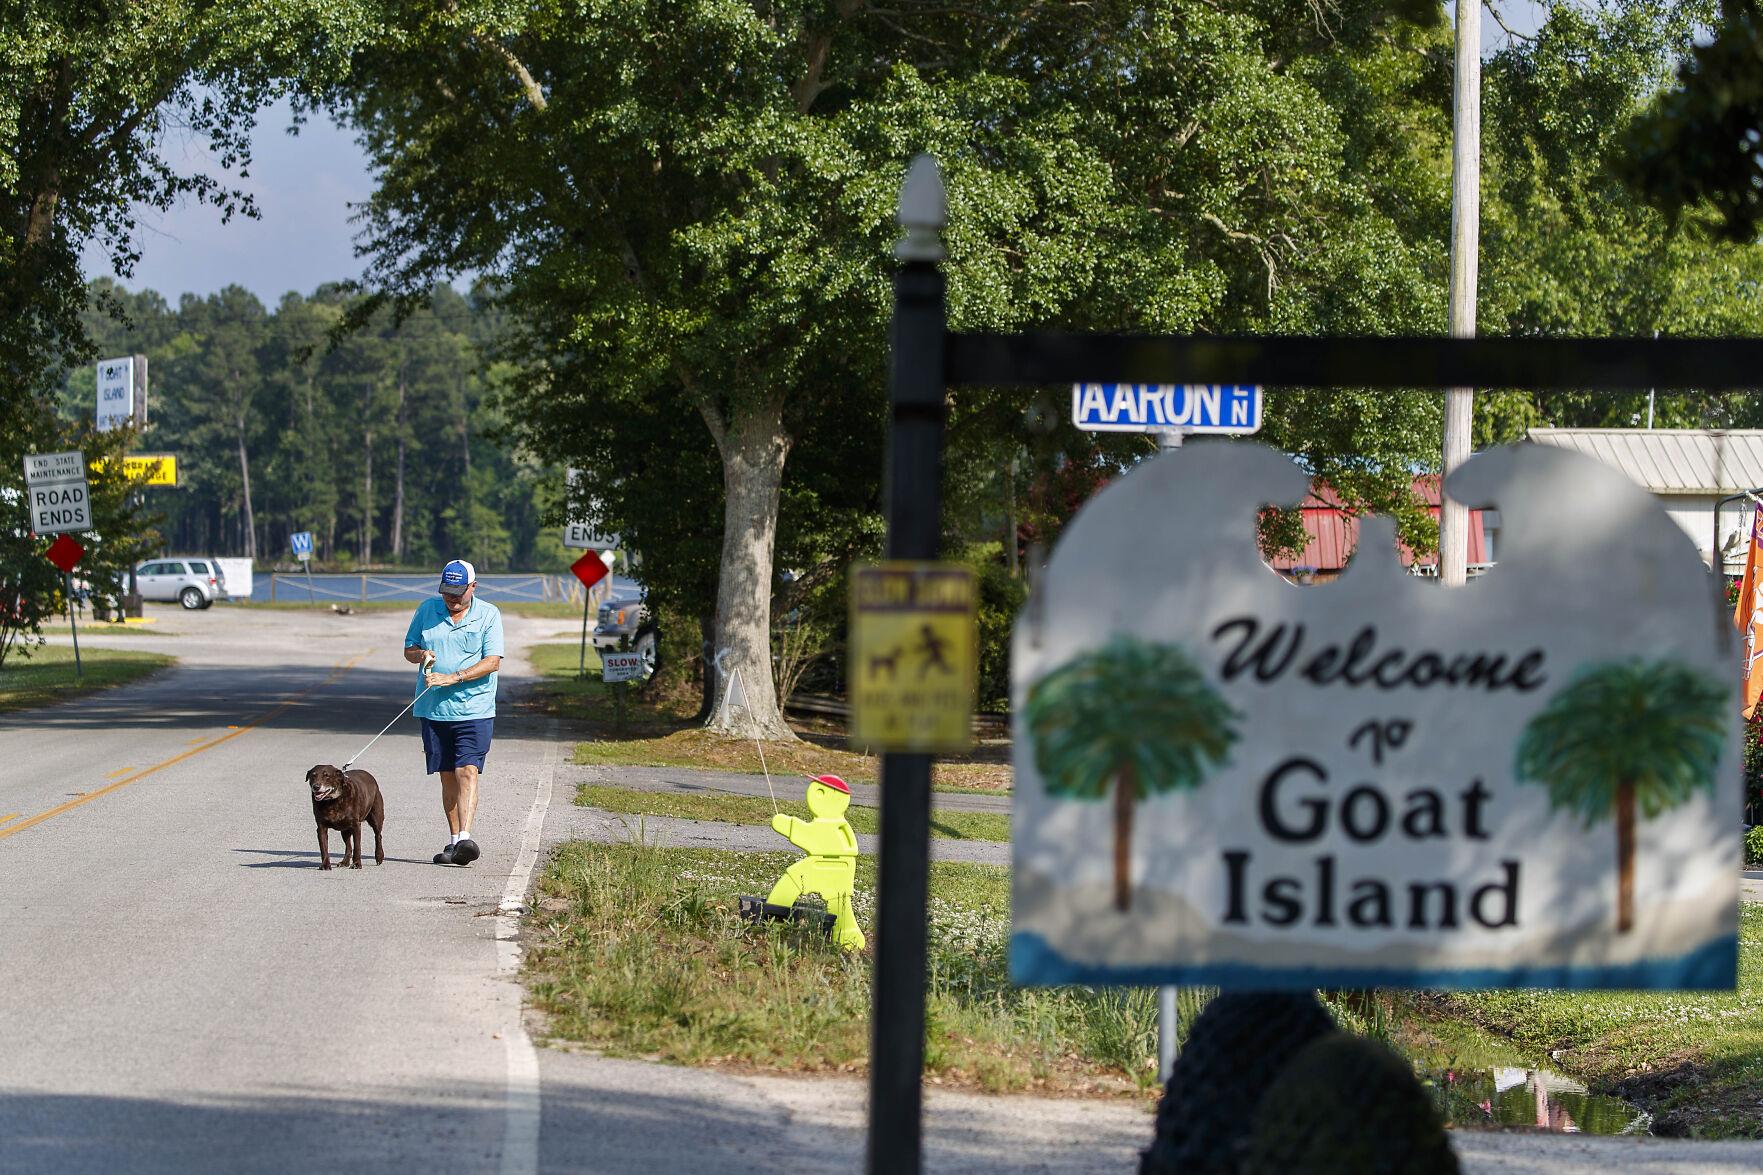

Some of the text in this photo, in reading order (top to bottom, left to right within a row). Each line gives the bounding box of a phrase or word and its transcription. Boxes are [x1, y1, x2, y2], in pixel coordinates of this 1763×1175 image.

[103, 386, 125, 401] ISLAND
[1079, 384, 1222, 426] AARON
[33, 456, 75, 469] END STATE
[30, 467, 80, 480] MAINTENANCE
[36, 488, 84, 507] ROAD
[39, 508, 85, 526] ENDS
[1211, 615, 1548, 692] Welcome
[607, 658, 638, 668] SLOW
[1257, 756, 1493, 845] Goat
[1222, 851, 1521, 930] Island
